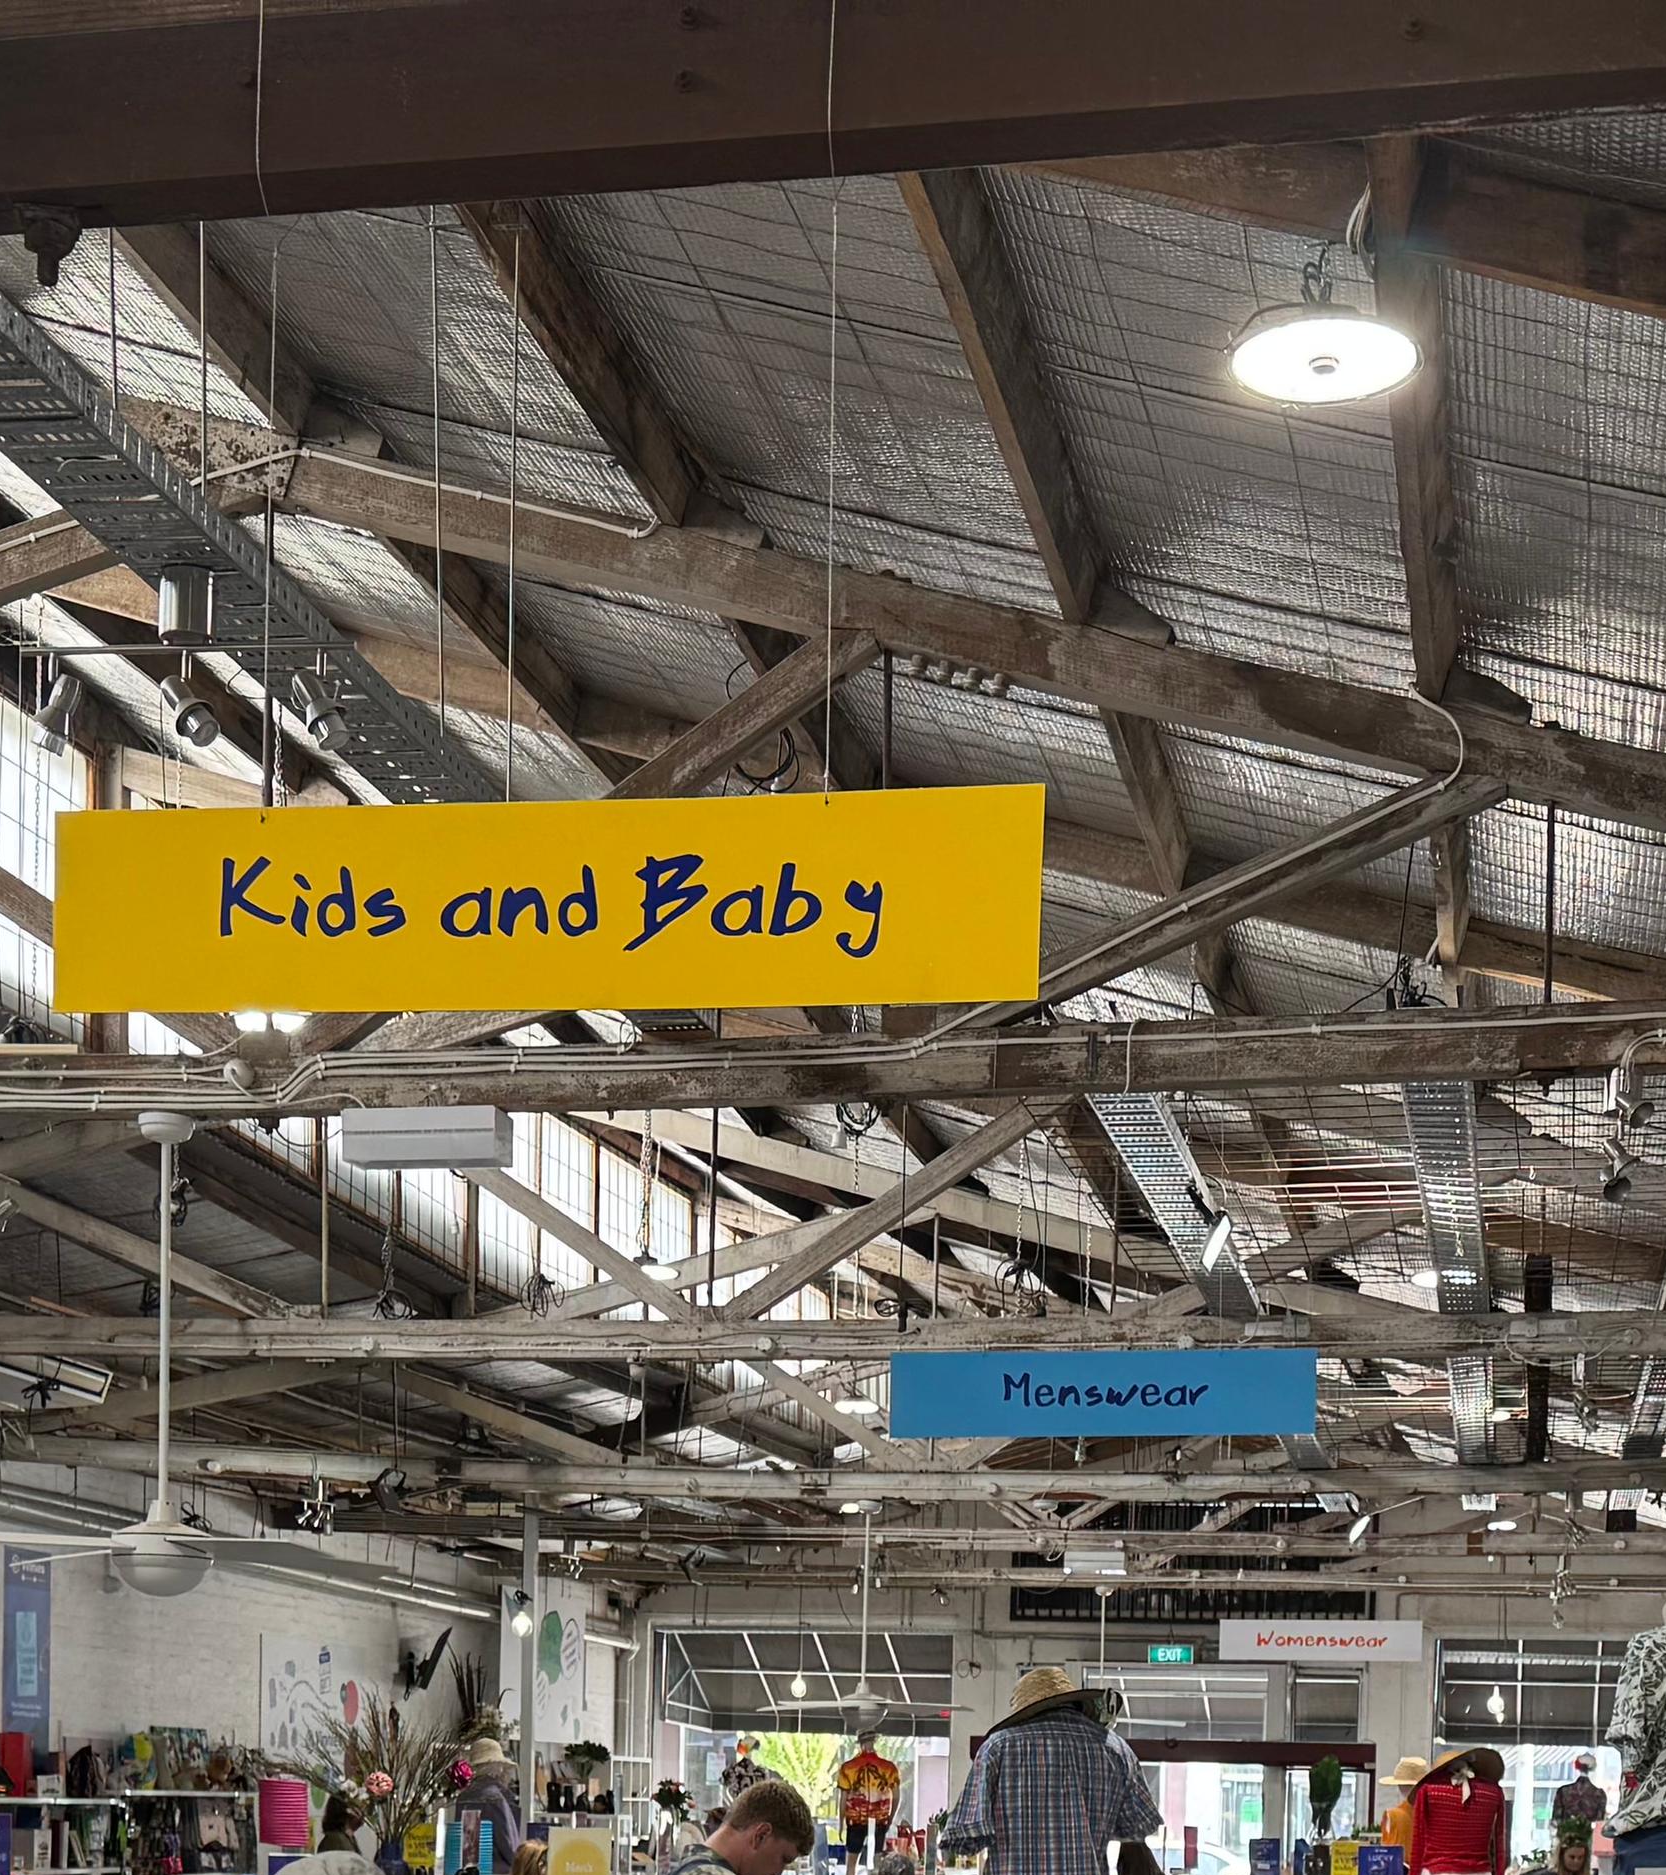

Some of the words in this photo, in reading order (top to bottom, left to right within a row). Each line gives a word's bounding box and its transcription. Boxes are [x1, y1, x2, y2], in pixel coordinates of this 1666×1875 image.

[218, 857, 408, 939] Kids
[441, 863, 599, 937] and
[622, 852, 885, 958] Baby
[1002, 1372, 1209, 1408] Menswear
[1256, 1631, 1388, 1648] Womenswear
[1158, 1648, 1182, 1661] EXIT
